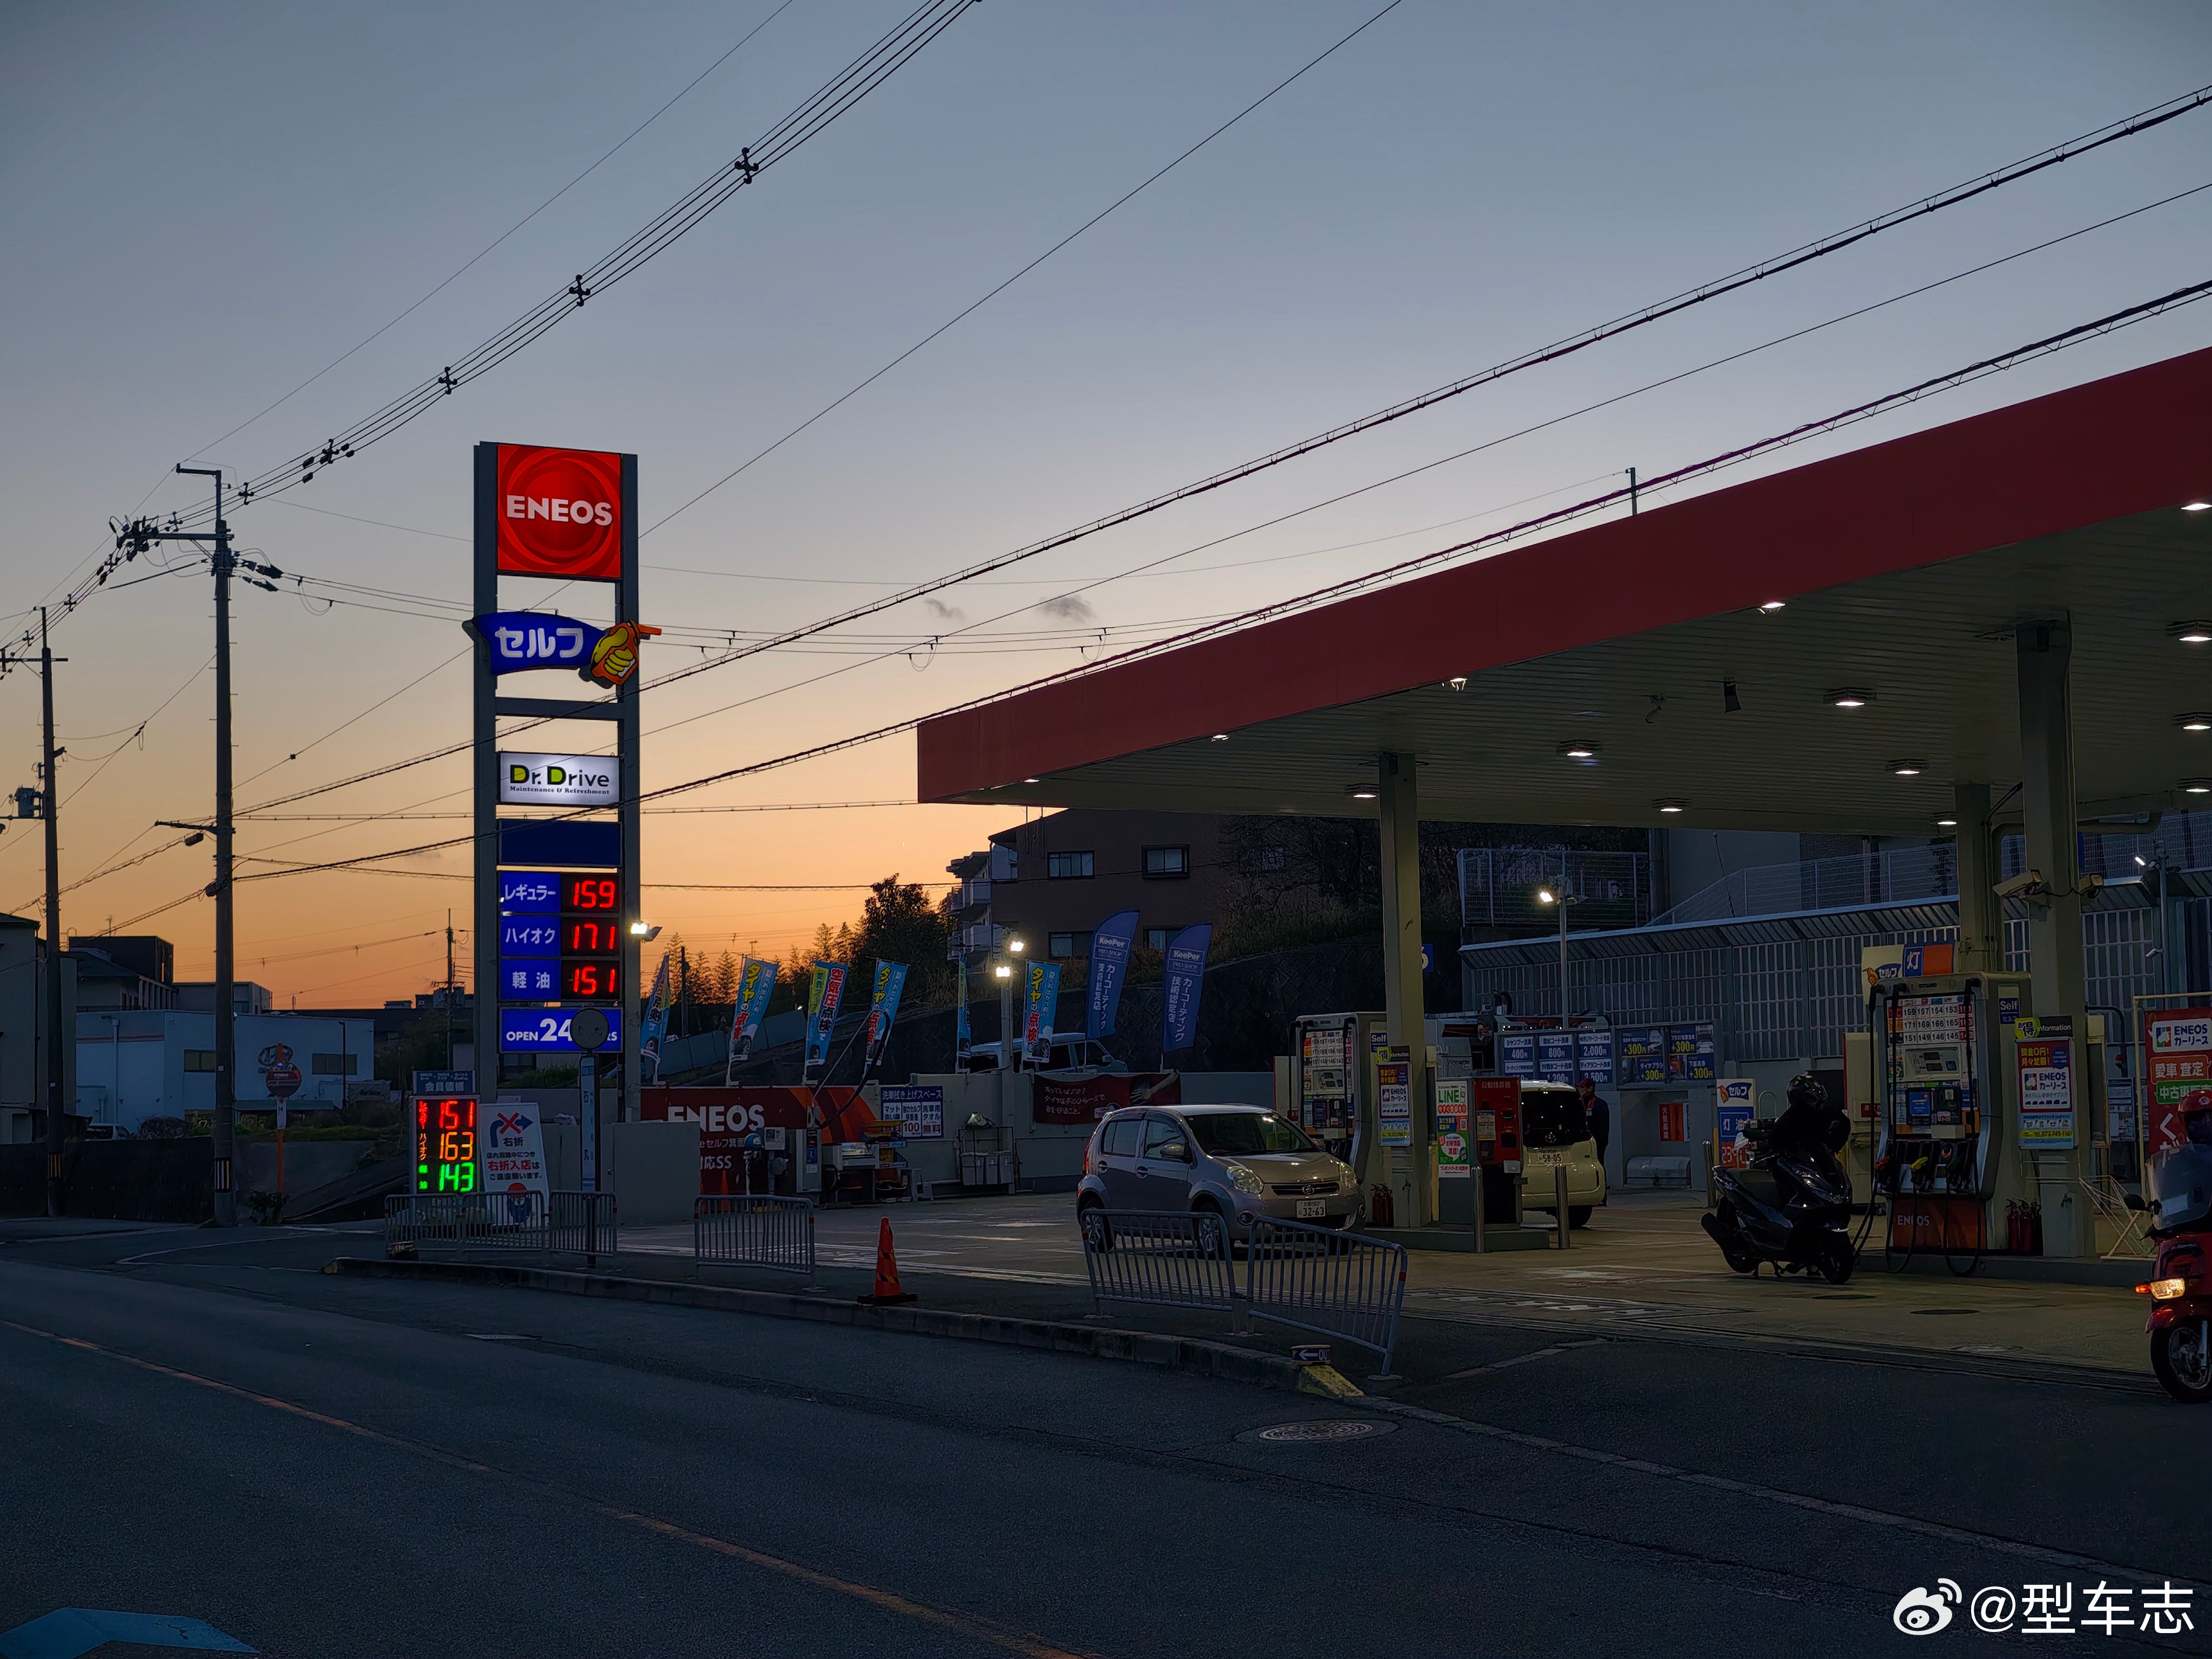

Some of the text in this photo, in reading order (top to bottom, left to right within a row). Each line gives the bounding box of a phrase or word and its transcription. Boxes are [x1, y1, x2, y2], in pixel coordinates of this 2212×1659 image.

[507, 495, 612, 526] ENEOS
[495, 626, 583, 658] セルフ
[505, 880, 615, 908] レギュラー 159
[505, 923, 615, 949] ハイオク 171
[1878, 967, 1897, 978] セルフ
[512, 967, 615, 994] 軽油 151
[1101, 963, 1116, 1030] カーコーティング
[1175, 977, 1192, 1042] カーコーティング
[2000, 1000, 2018, 1010] Self
[2174, 1024, 2208, 1035] ENEOS
[506, 1031, 538, 1041] OPEN
[1372, 1034, 1387, 1043] Self
[2174, 1036, 2209, 1047] カーリース
[1583, 1045, 1608, 1057] 2,000円
[1689, 1068, 1714, 1079] +300円
[2039, 1072, 2067, 1081] ENEOS
[1728, 1086, 1748, 1096] セルフ
[2040, 1082, 2067, 1090] カーリース
[1438, 1089, 1459, 1103] LINE
[439, 1101, 474, 1130] 151
[668, 1104, 765, 1133] ENEOS
[904, 1122, 920, 1132] 100
[923, 1124, 941, 1134] 無料
[439, 1131, 474, 1161] 163
[503, 1137, 524, 1147] 右折
[487, 1159, 541, 1171] 右折入店は
[438, 1162, 475, 1192] 143
[1303, 1206, 1324, 1216] 32-63
[1897, 1215, 1930, 1226] ENOS
